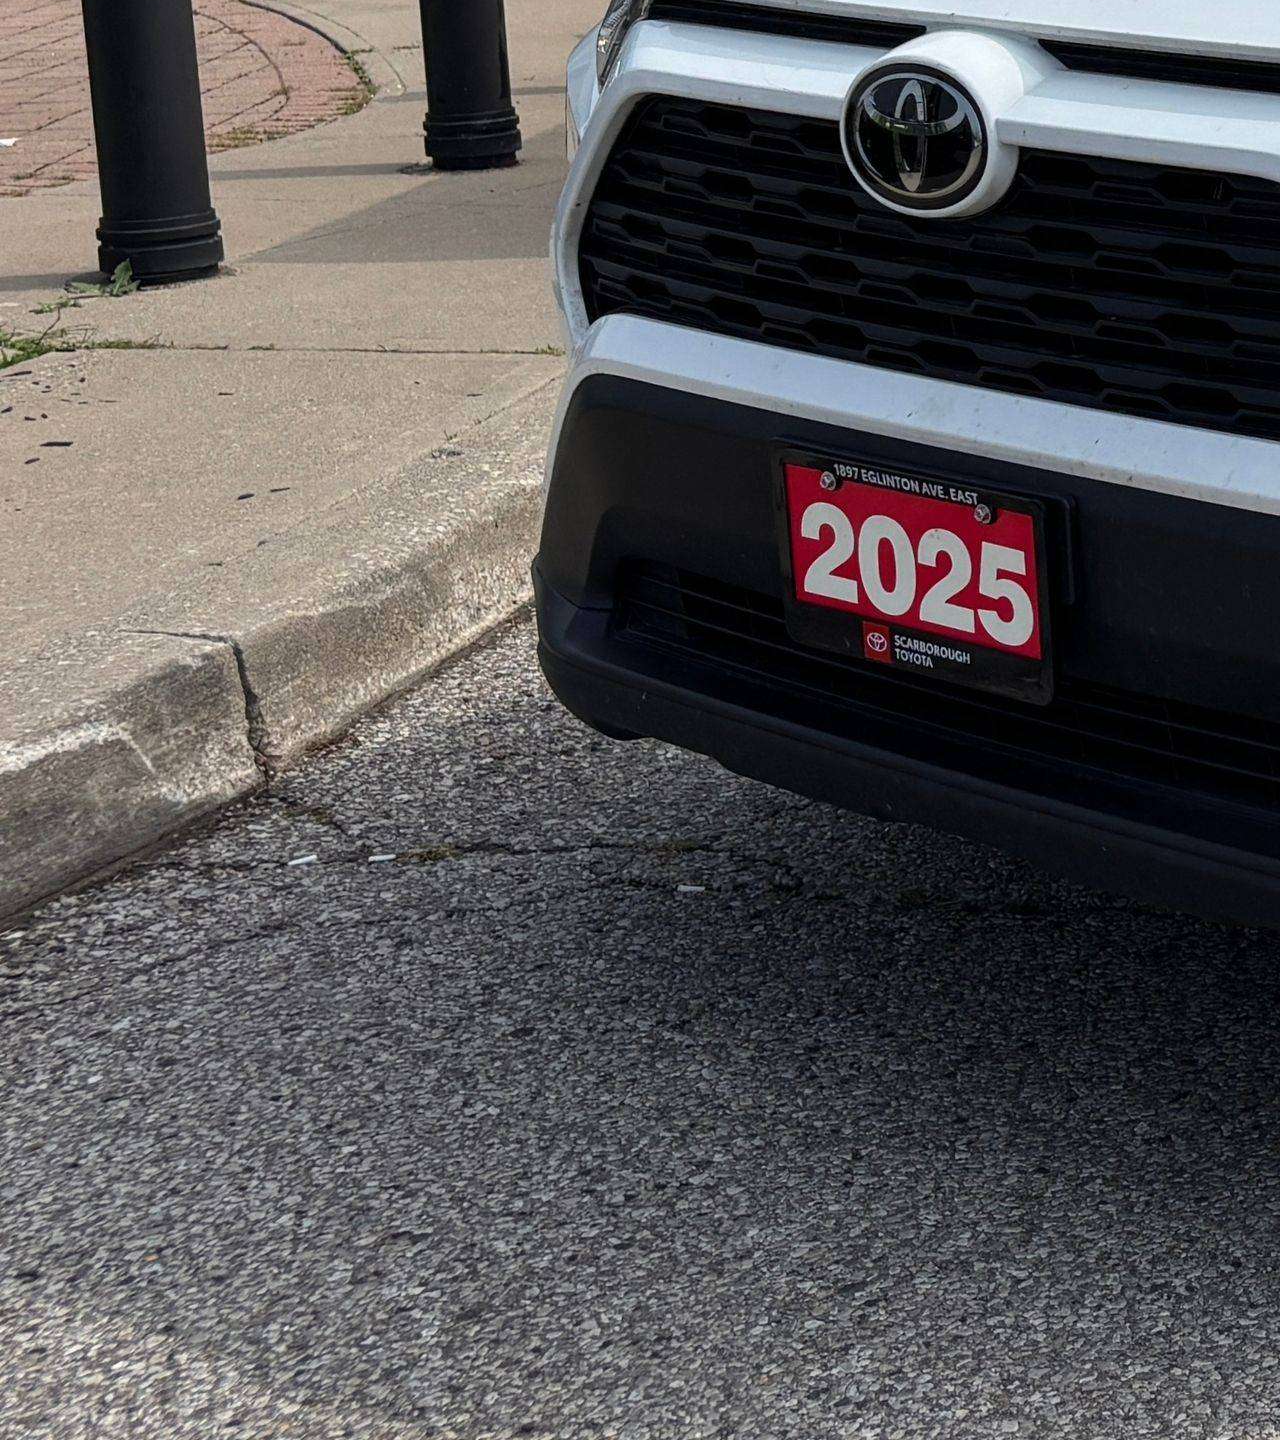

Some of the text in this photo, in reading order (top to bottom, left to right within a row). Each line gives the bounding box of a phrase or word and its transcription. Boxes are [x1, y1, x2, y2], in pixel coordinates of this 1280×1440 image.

[833, 463, 979, 506] 1897 EGLINTON AVE. EAST
[801, 501, 1034, 647] 2025
[894, 634, 971, 665] SCARBOROUGH
[894, 647, 934, 669] TOYOTA
